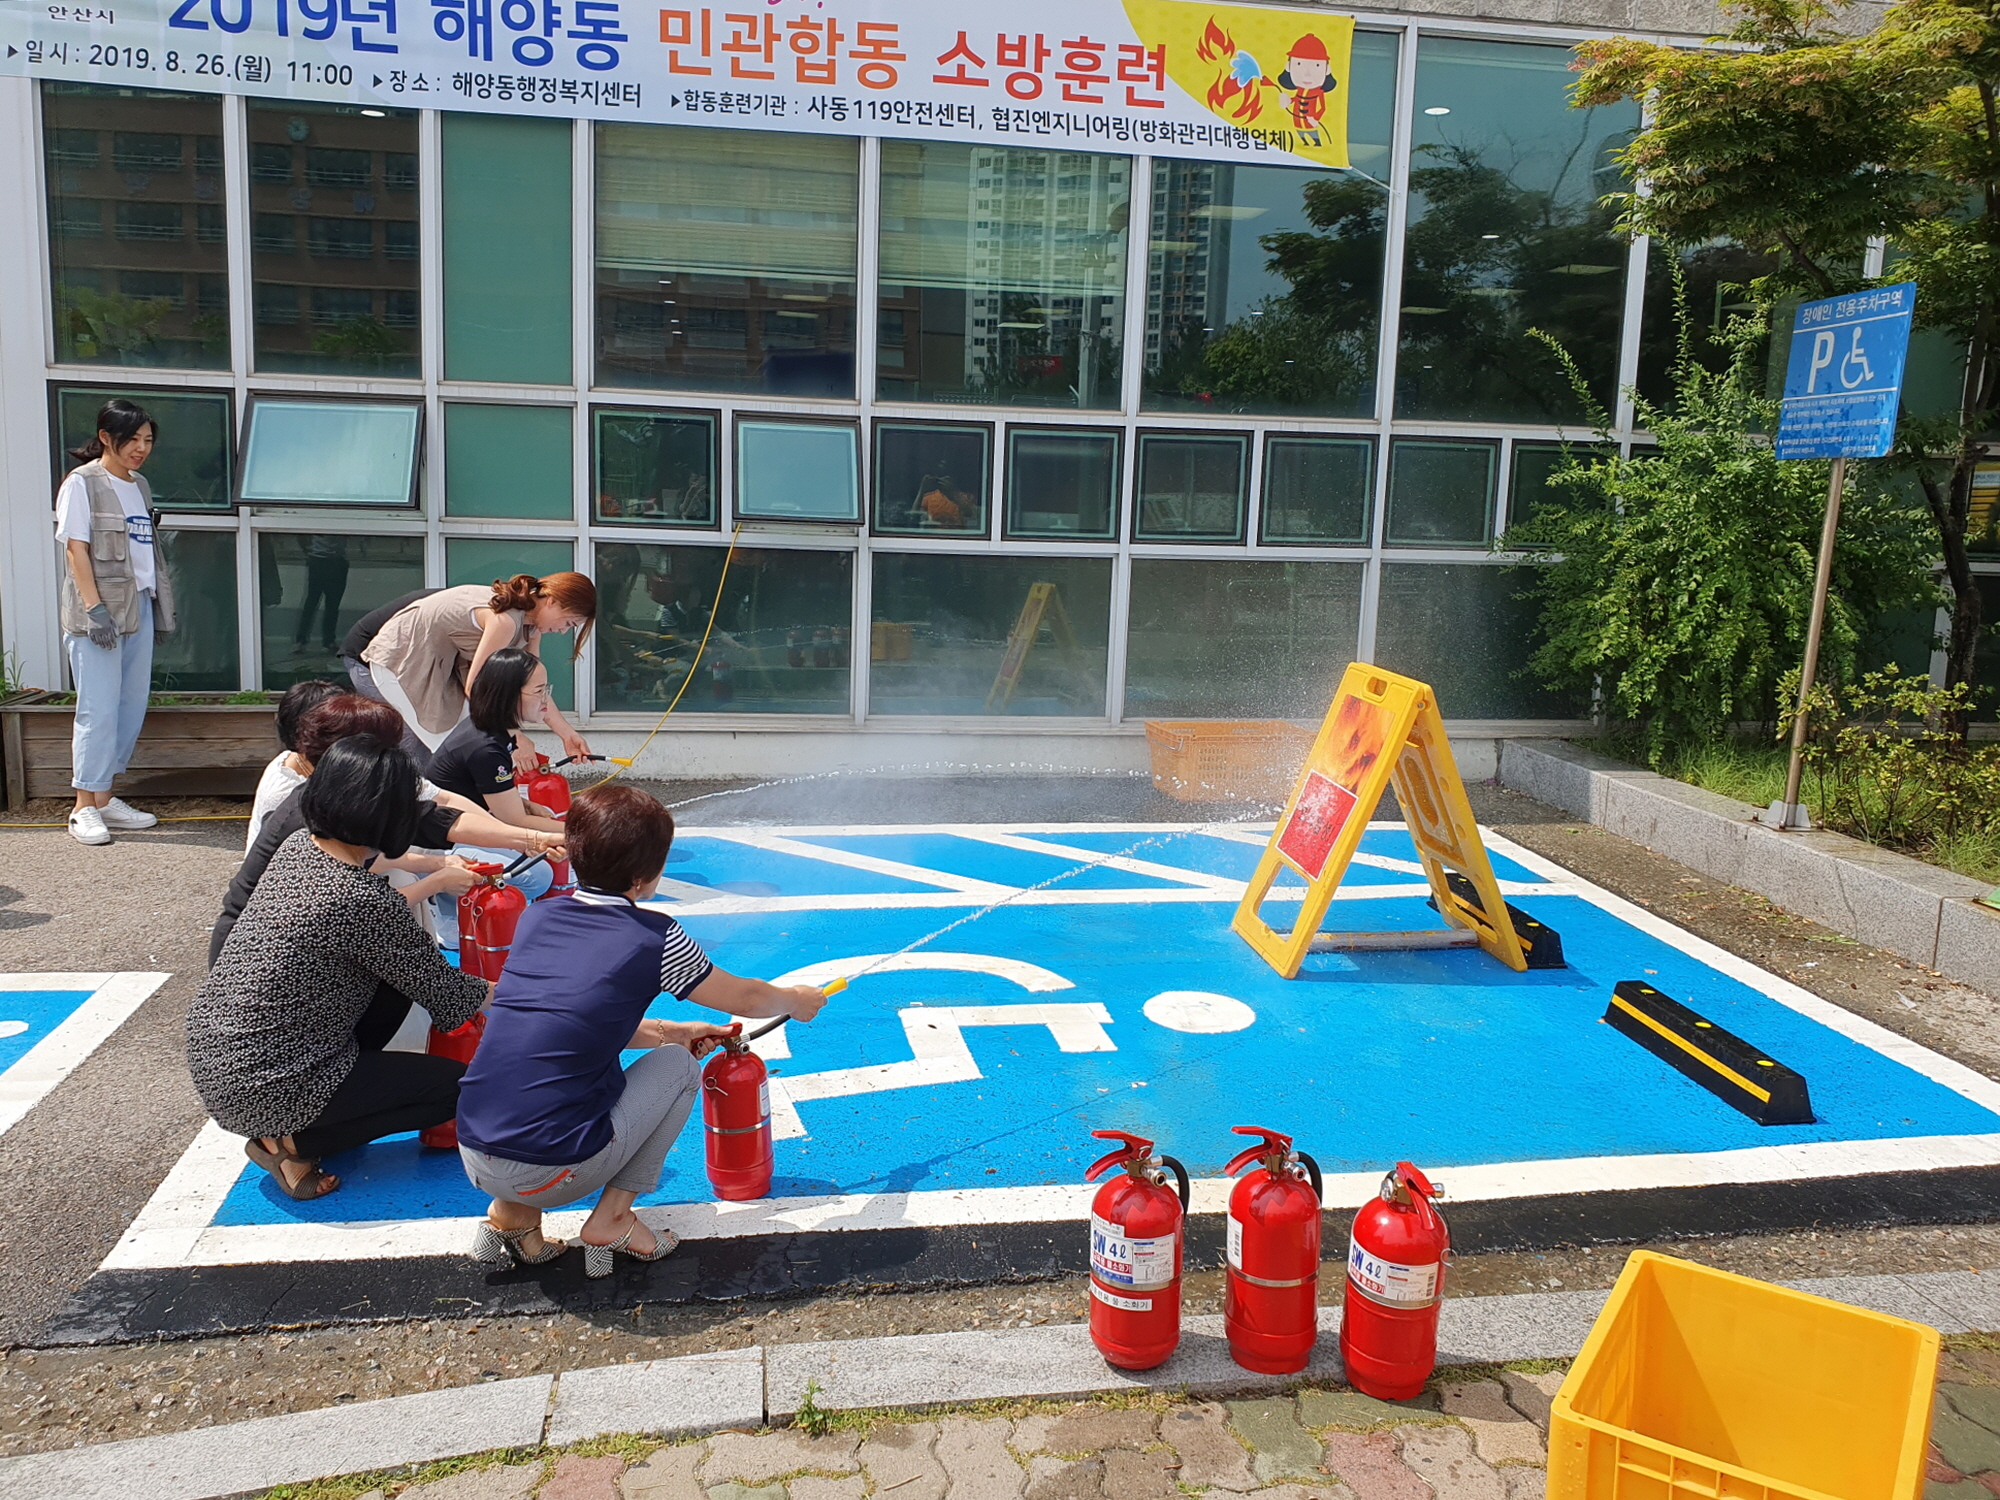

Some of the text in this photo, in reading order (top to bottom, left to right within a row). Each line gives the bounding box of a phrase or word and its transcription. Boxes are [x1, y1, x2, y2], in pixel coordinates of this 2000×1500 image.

[47, 5, 115, 25] 안산시
[88, 44, 157, 72] 2019.
[165, 51, 186, 74] 8.
[286, 60, 353, 87] 11:00
[431, 0, 629, 72] 해양동
[659, 8, 906, 90] 민관합동
[932, 30, 1166, 109] 소방훈련
[452, 71, 642, 109] 해양동행정복지센터
[683, 89, 787, 117] 합동훈련기관
[1802, 290, 1903, 325] 장애인 전용주차구역
[1807, 331, 1835, 394] P
[1122, 1300, 1149, 1309] 소화기
